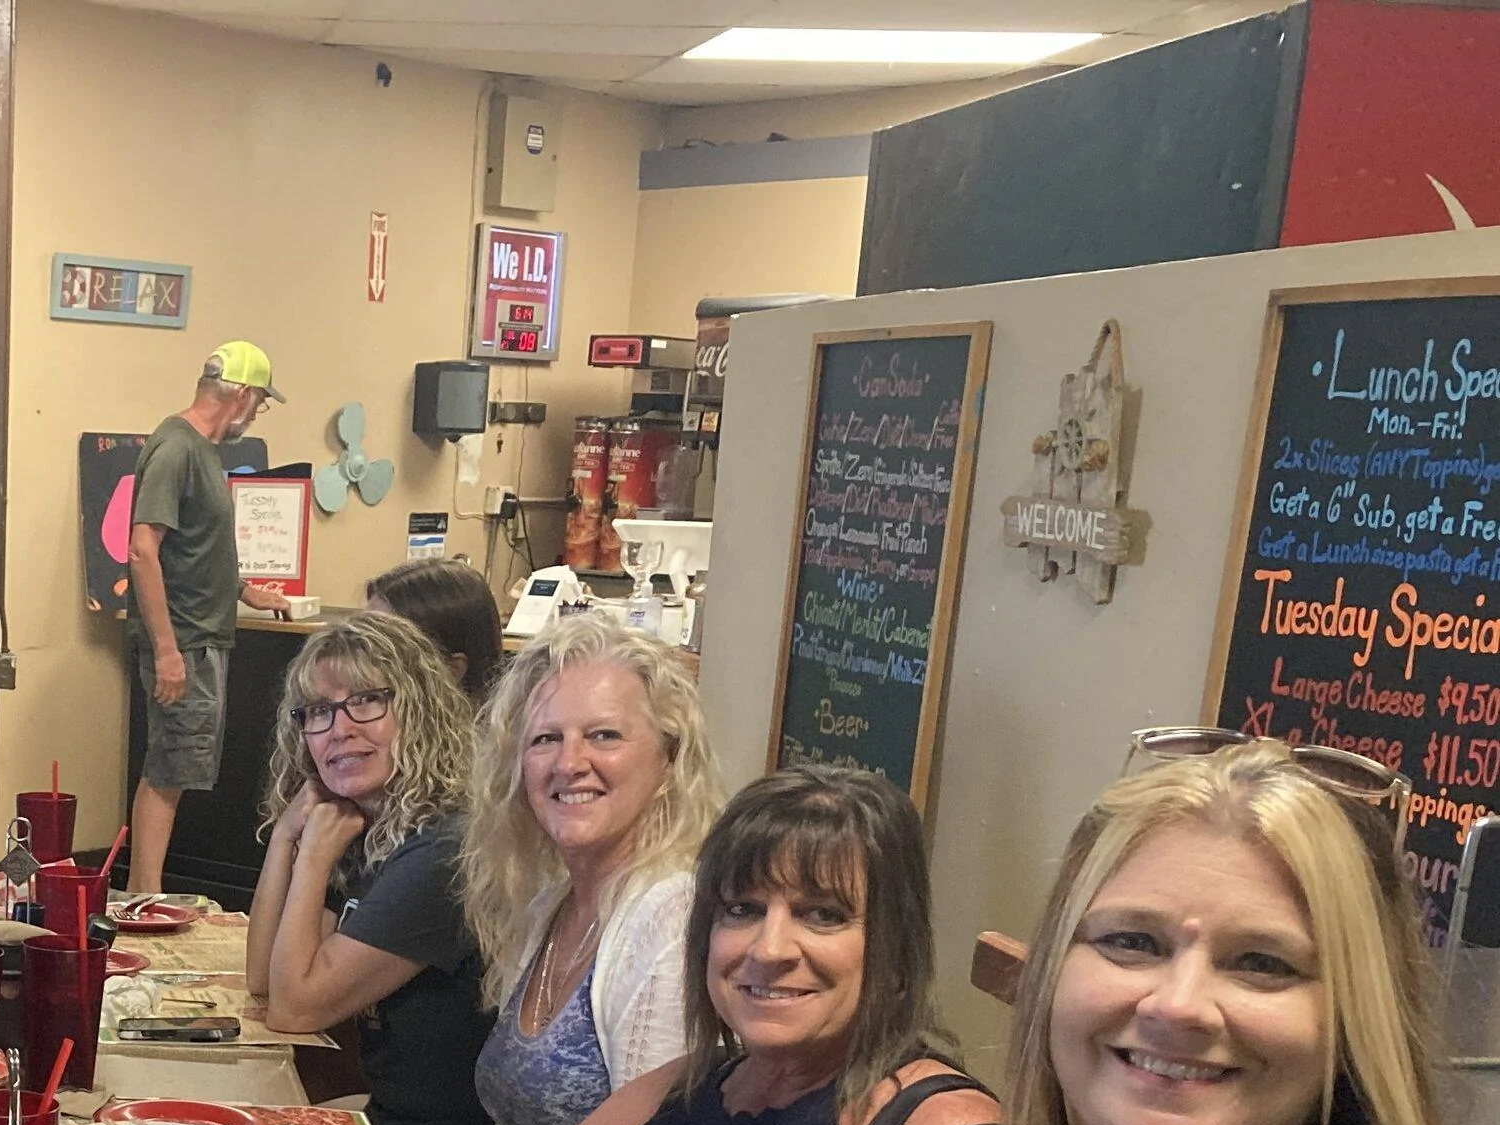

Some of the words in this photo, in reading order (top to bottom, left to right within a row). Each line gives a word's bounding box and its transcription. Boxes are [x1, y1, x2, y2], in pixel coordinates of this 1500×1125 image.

[493, 241, 518, 280] We
[522, 245, 548, 283] I.D.
[93, 272, 176, 310] RELAX
[1328, 328, 1438, 404] Lunch
[1017, 501, 1107, 550] WELCOME
[1270, 481, 1311, 517] Get
[1308, 500, 1321, 520] a
[1402, 495, 1444, 544] get
[1440, 515, 1455, 536] a
[1258, 526, 1296, 561] Get
[1311, 530, 1370, 565] Lunch
[1254, 569, 1379, 668] Tuesday
[1270, 655, 1343, 720] Large
[1346, 670, 1426, 719] Cheese
[819, 698, 863, 739] Beer
